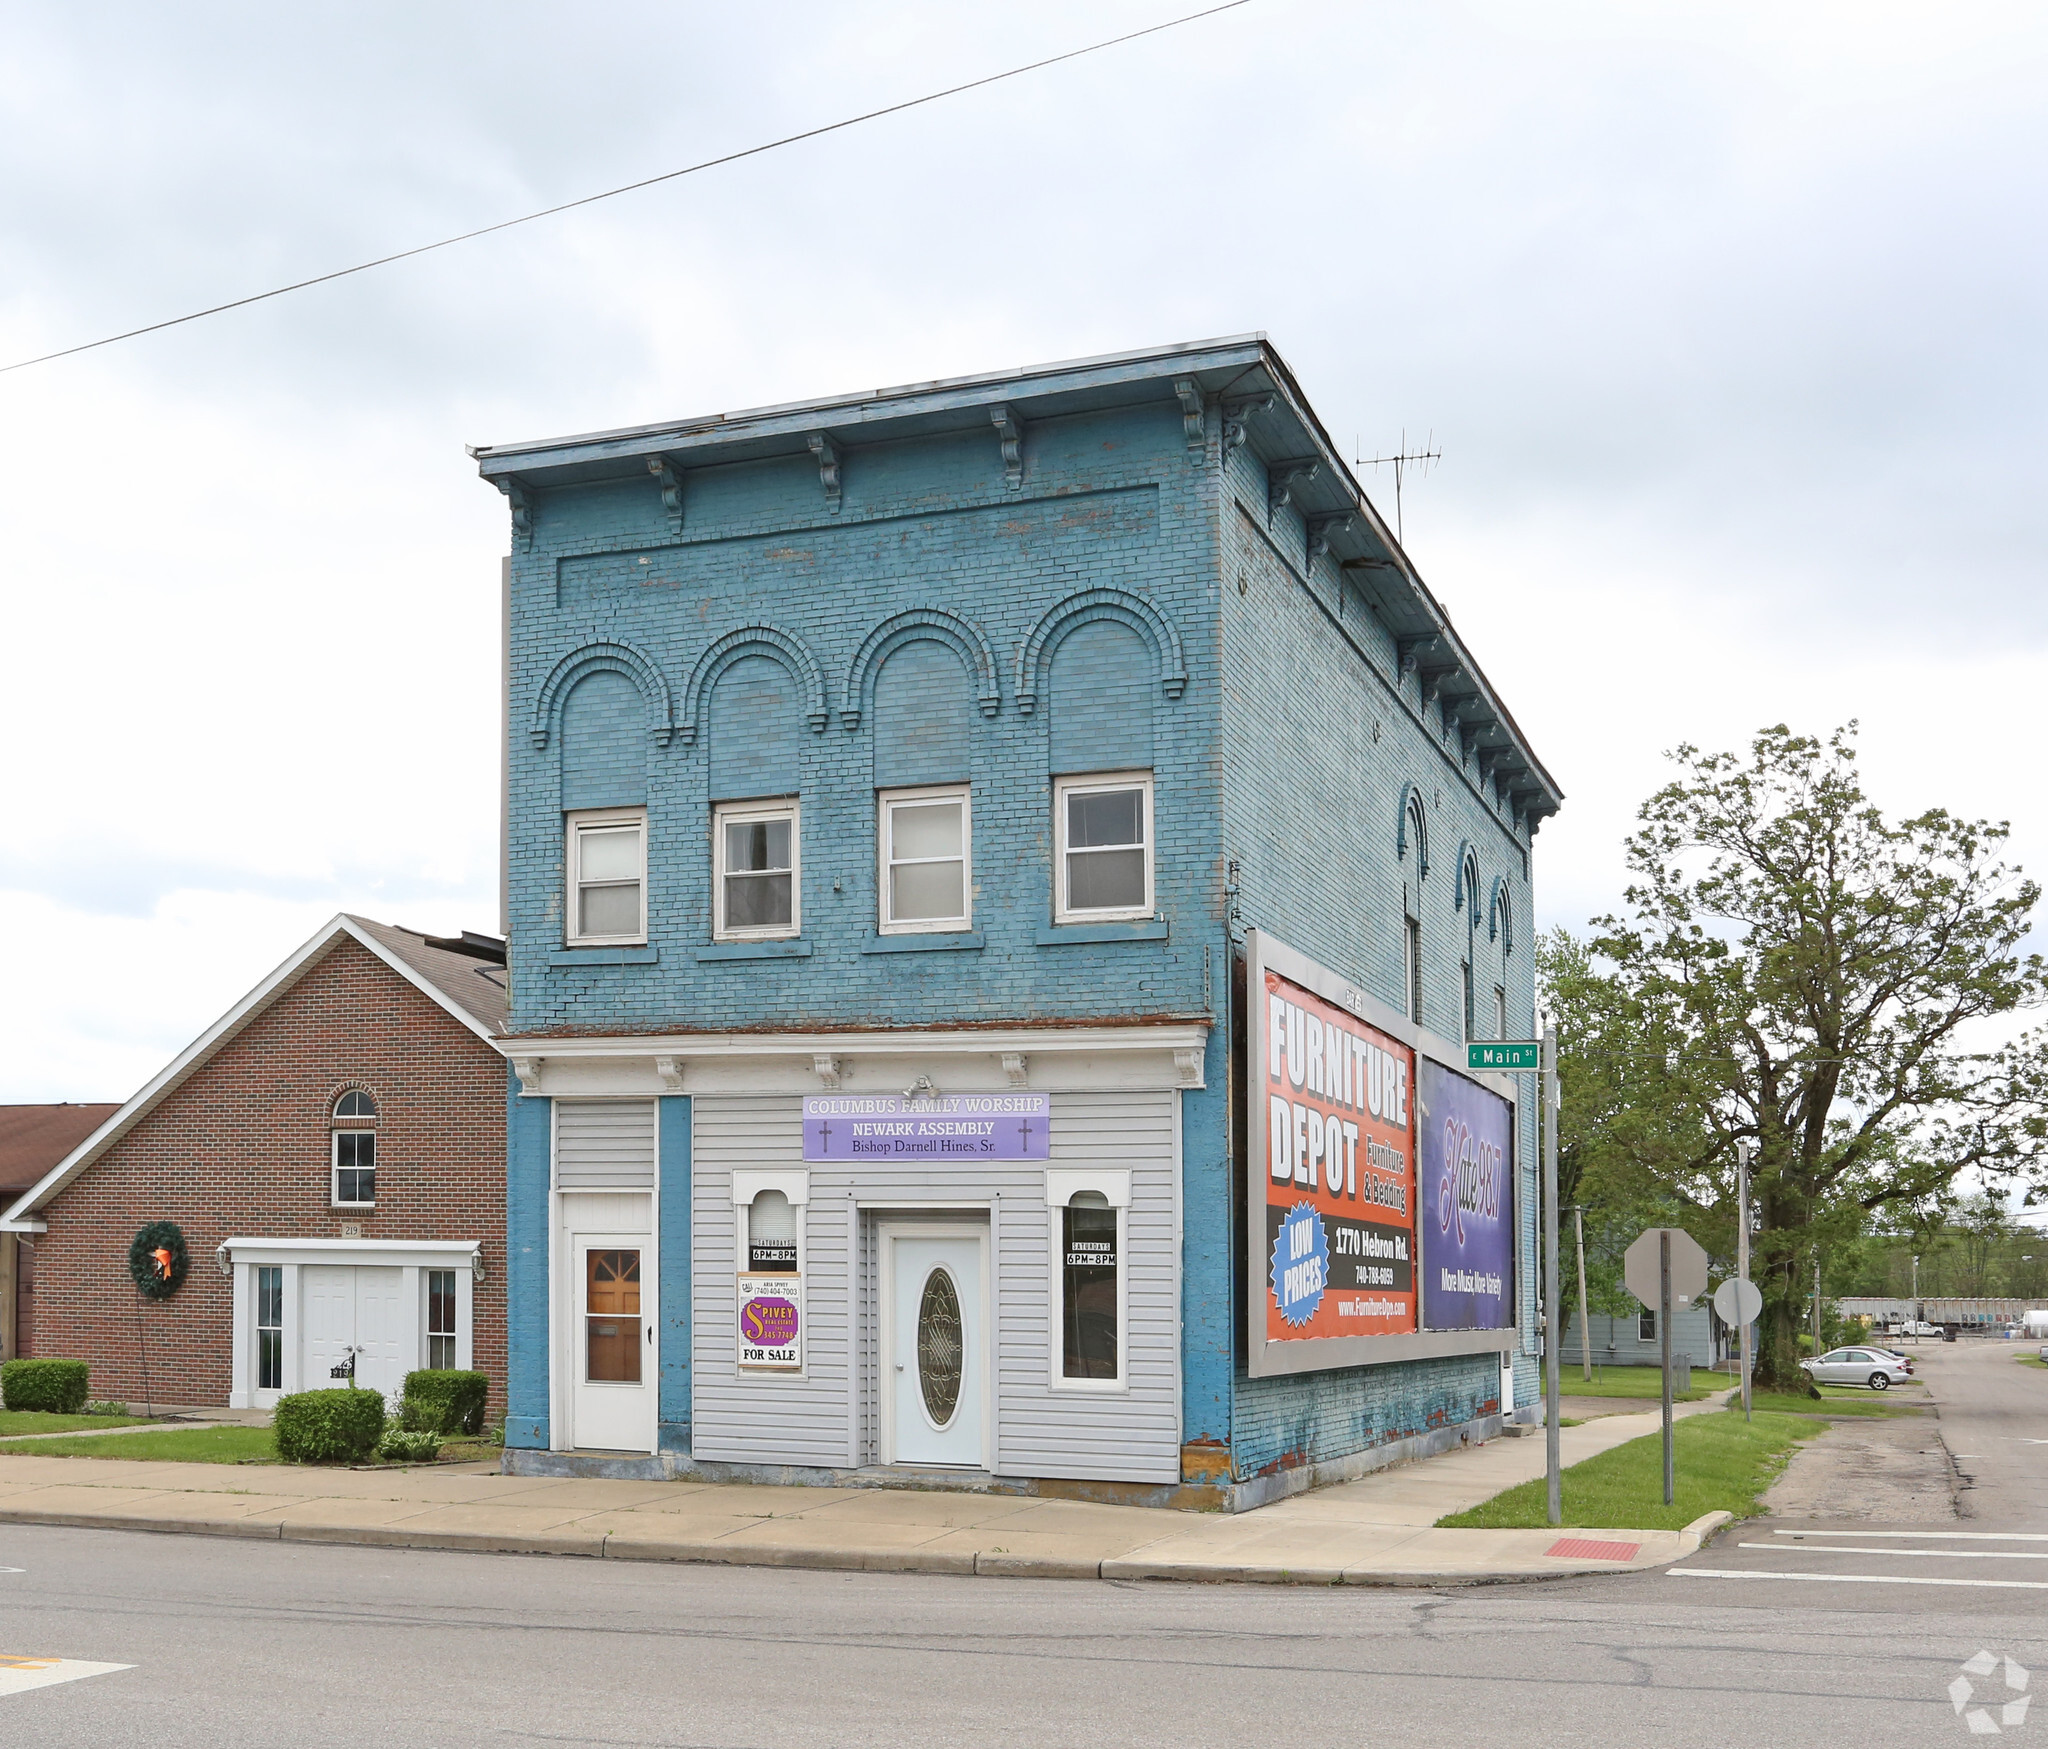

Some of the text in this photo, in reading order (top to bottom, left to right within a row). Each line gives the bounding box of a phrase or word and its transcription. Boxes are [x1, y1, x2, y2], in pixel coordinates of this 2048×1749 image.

[1269, 992, 1407, 1132] FURNITURE
[1472, 1049, 1533, 1064] E Main St
[808, 1097, 1043, 1115] COLUMBUS FAMILY WORSHIP
[852, 1121, 995, 1136] NEWARK ASSEMBLY
[852, 1139, 996, 1155] Bishop Darnell Hines, Sr.
[1270, 1094, 1359, 1201] DEPOT
[1366, 1133, 1405, 1176] Furniture
[1363, 1171, 1407, 1218] & Bedding
[1439, 1117, 1502, 1246] Kate 98.7
[345, 1226, 358, 1236] 219
[1290, 1217, 1314, 1261] LOW
[1336, 1226, 1409, 1262] 1770 Hebron Rd.
[754, 1251, 796, 1259] 6PM-8PM
[1068, 1255, 1115, 1264] 6PM-8PM
[1284, 1255, 1322, 1307] PRICES
[1441, 1267, 1502, 1301] More Music, More Variety
[746, 1303, 793, 1339] SPIVEY
[743, 1349, 796, 1361] FOR SALE
